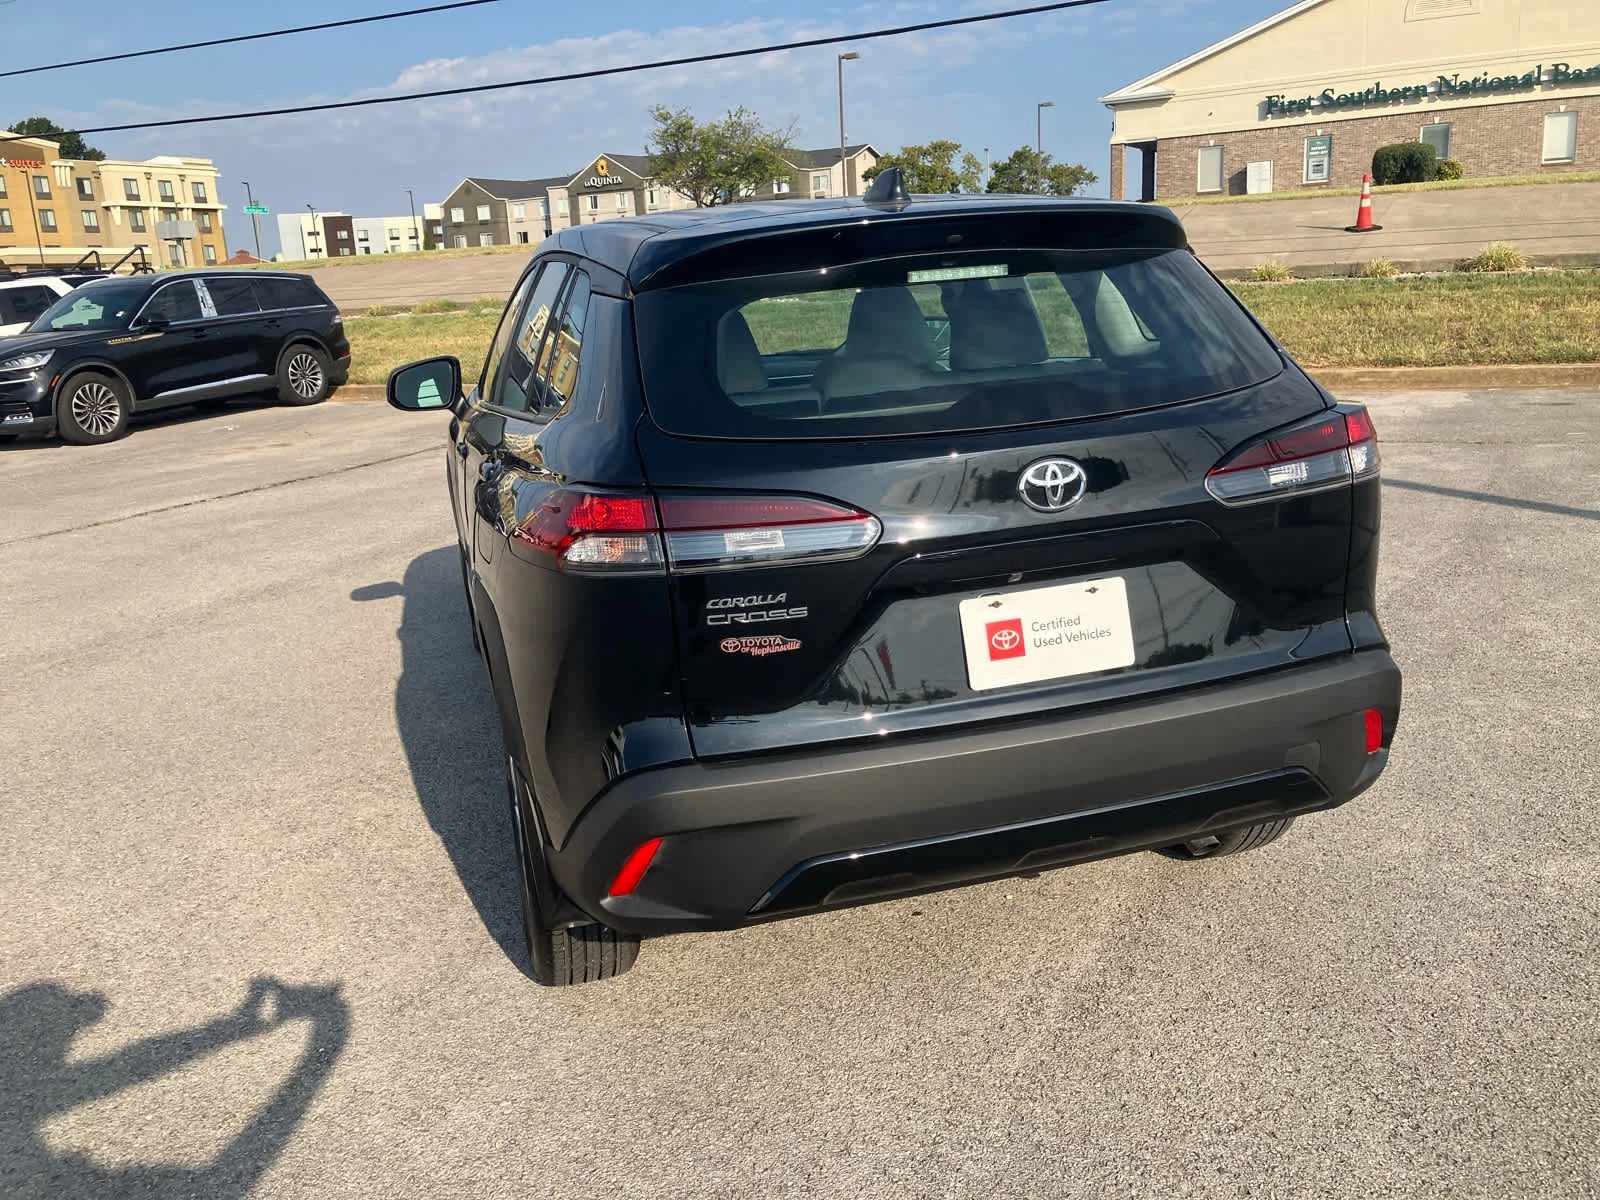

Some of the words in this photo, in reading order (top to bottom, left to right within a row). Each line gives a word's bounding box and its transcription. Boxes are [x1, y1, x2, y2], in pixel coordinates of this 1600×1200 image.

[1265, 95, 1313, 115] First
[1320, 81, 1428, 108] Southern
[1437, 64, 1544, 96] National
[10, 159, 42, 169] SUITES
[590, 176, 622, 187] QUINTA
[706, 592, 787, 609] COROLLA
[706, 606, 808, 625] CROSS
[1031, 615, 1081, 632] Certified
[741, 637, 782, 647] TOYOTA
[1033, 633, 1063, 648] Used
[1065, 627, 1112, 643] Vehicles
[750, 641, 801, 656] Hopkinsville
